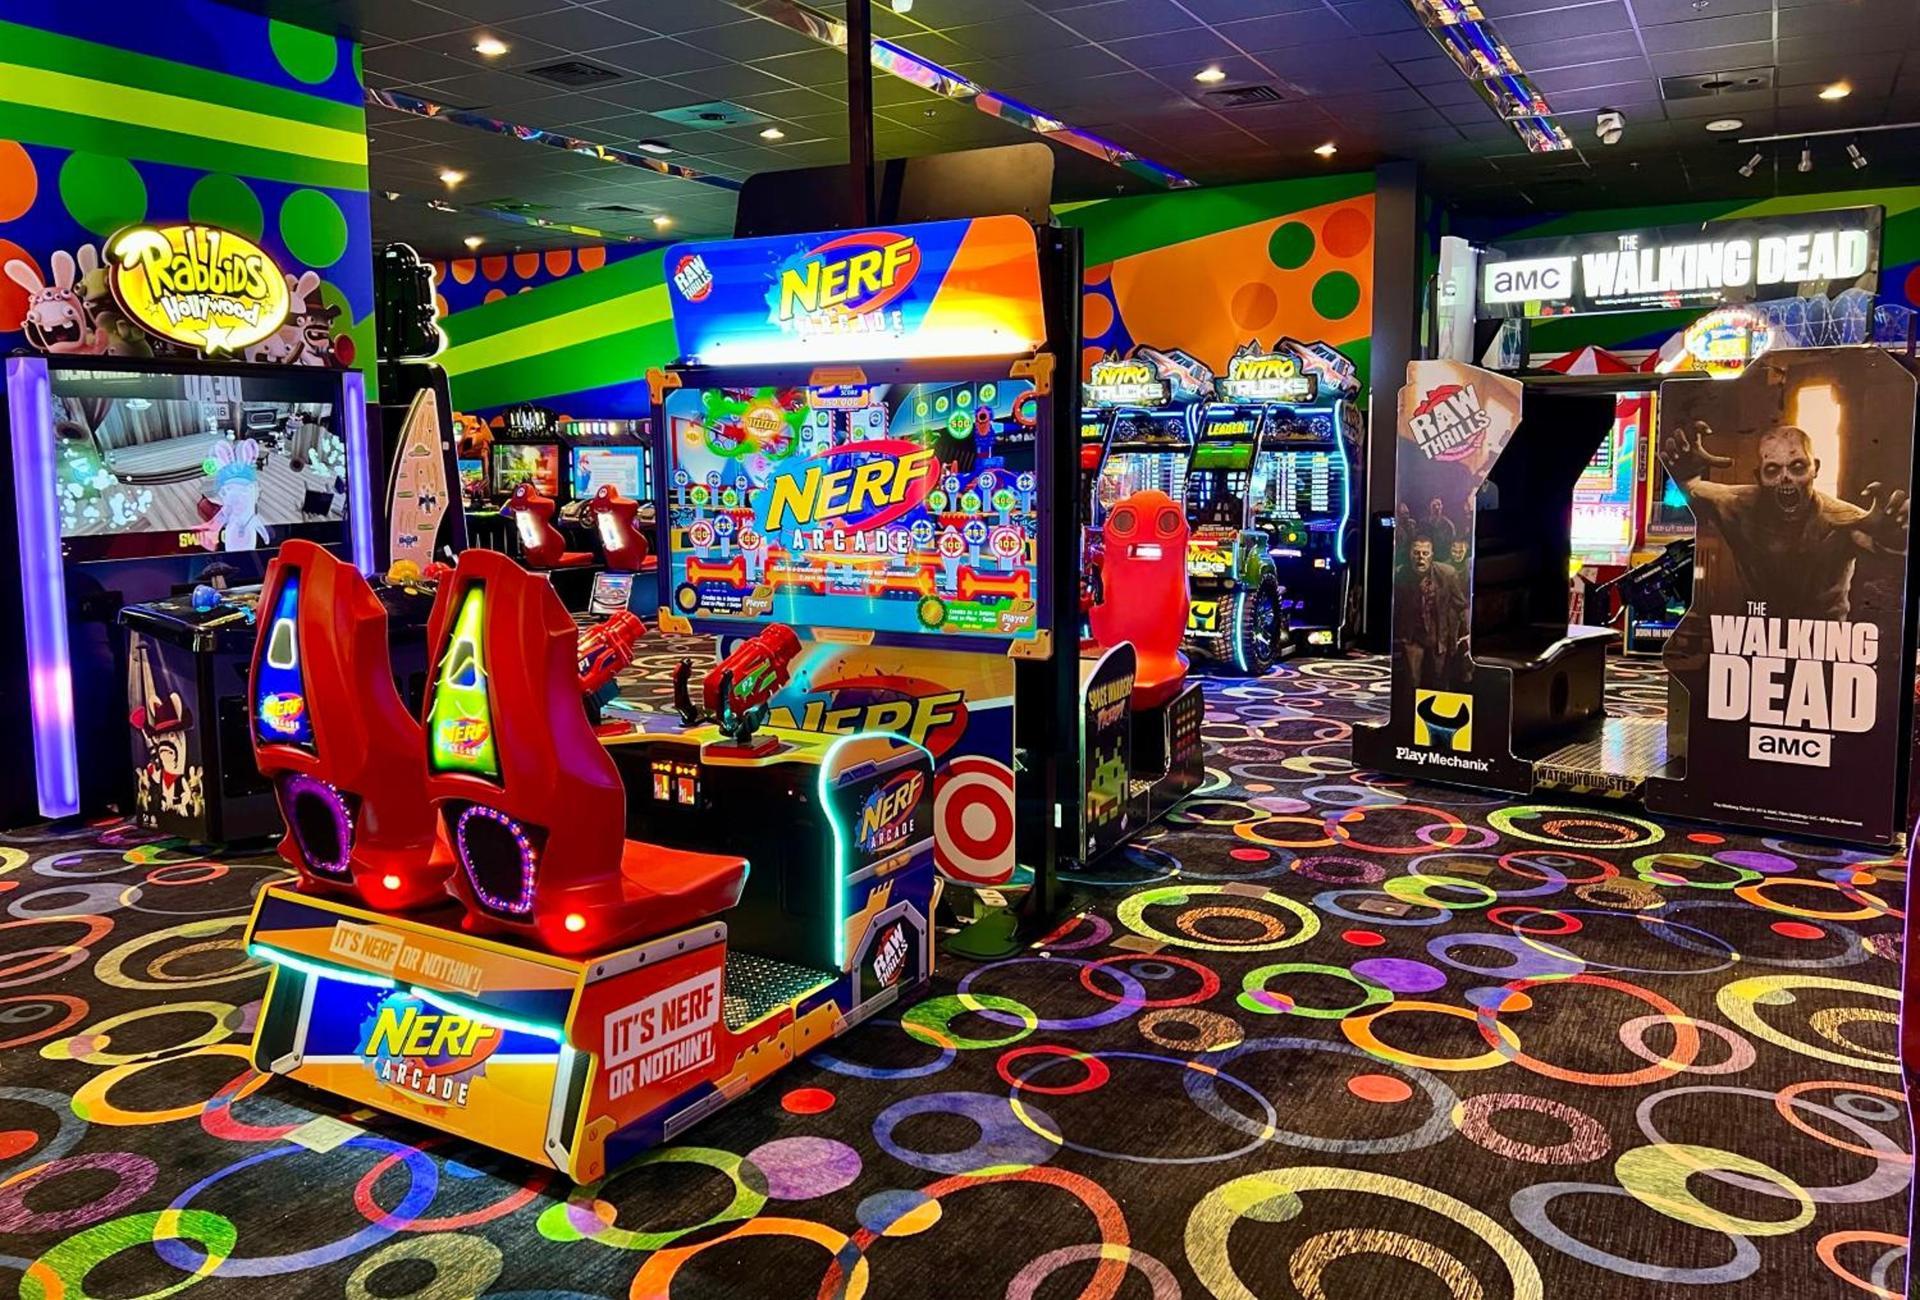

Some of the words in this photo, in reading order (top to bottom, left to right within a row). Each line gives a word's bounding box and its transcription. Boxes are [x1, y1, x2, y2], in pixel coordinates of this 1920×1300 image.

[1582, 241, 1753, 297] WALKING
[1757, 229, 1869, 285] DEAD
[1617, 235, 1638, 251] THE
[674, 254, 706, 292] RAW
[780, 236, 915, 321] NERF
[160, 294, 261, 327] Hollywood
[1098, 366, 1149, 385] NITRO
[1236, 360, 1295, 381] NITRO
[1408, 384, 1481, 445] RAW
[1421, 409, 1492, 460] THRILLS
[765, 449, 936, 532] NERF
[793, 529, 909, 552] ARCADE
[746, 599, 767, 607] Player
[1002, 613, 1029, 623] Player
[1747, 601, 1767, 616] THE
[1004, 623, 1010, 632] 2
[1710, 614, 1878, 665] WALKING
[1708, 653, 1878, 733] DEAD
[1396, 747, 1428, 765] Play
[1429, 752, 1488, 772] Mechanix
[1575, 770, 1606, 789] YOUR
[1607, 776, 1636, 792] STEP
[860, 772, 923, 843] NERF
[870, 818, 915, 849] ARCADE
[335, 928, 362, 952] IT'S
[361, 934, 398, 962] NERF
[400, 945, 423, 971] OR
[873, 923, 905, 980] RAW
[879, 940, 909, 988] THRILLS
[366, 1006, 496, 1057] NERF
[612, 1007, 655, 1057] IT'S
[661, 983, 714, 1035] NERF
[380, 1060, 470, 1105] ARCADE
[609, 1063, 635, 1100] OR
